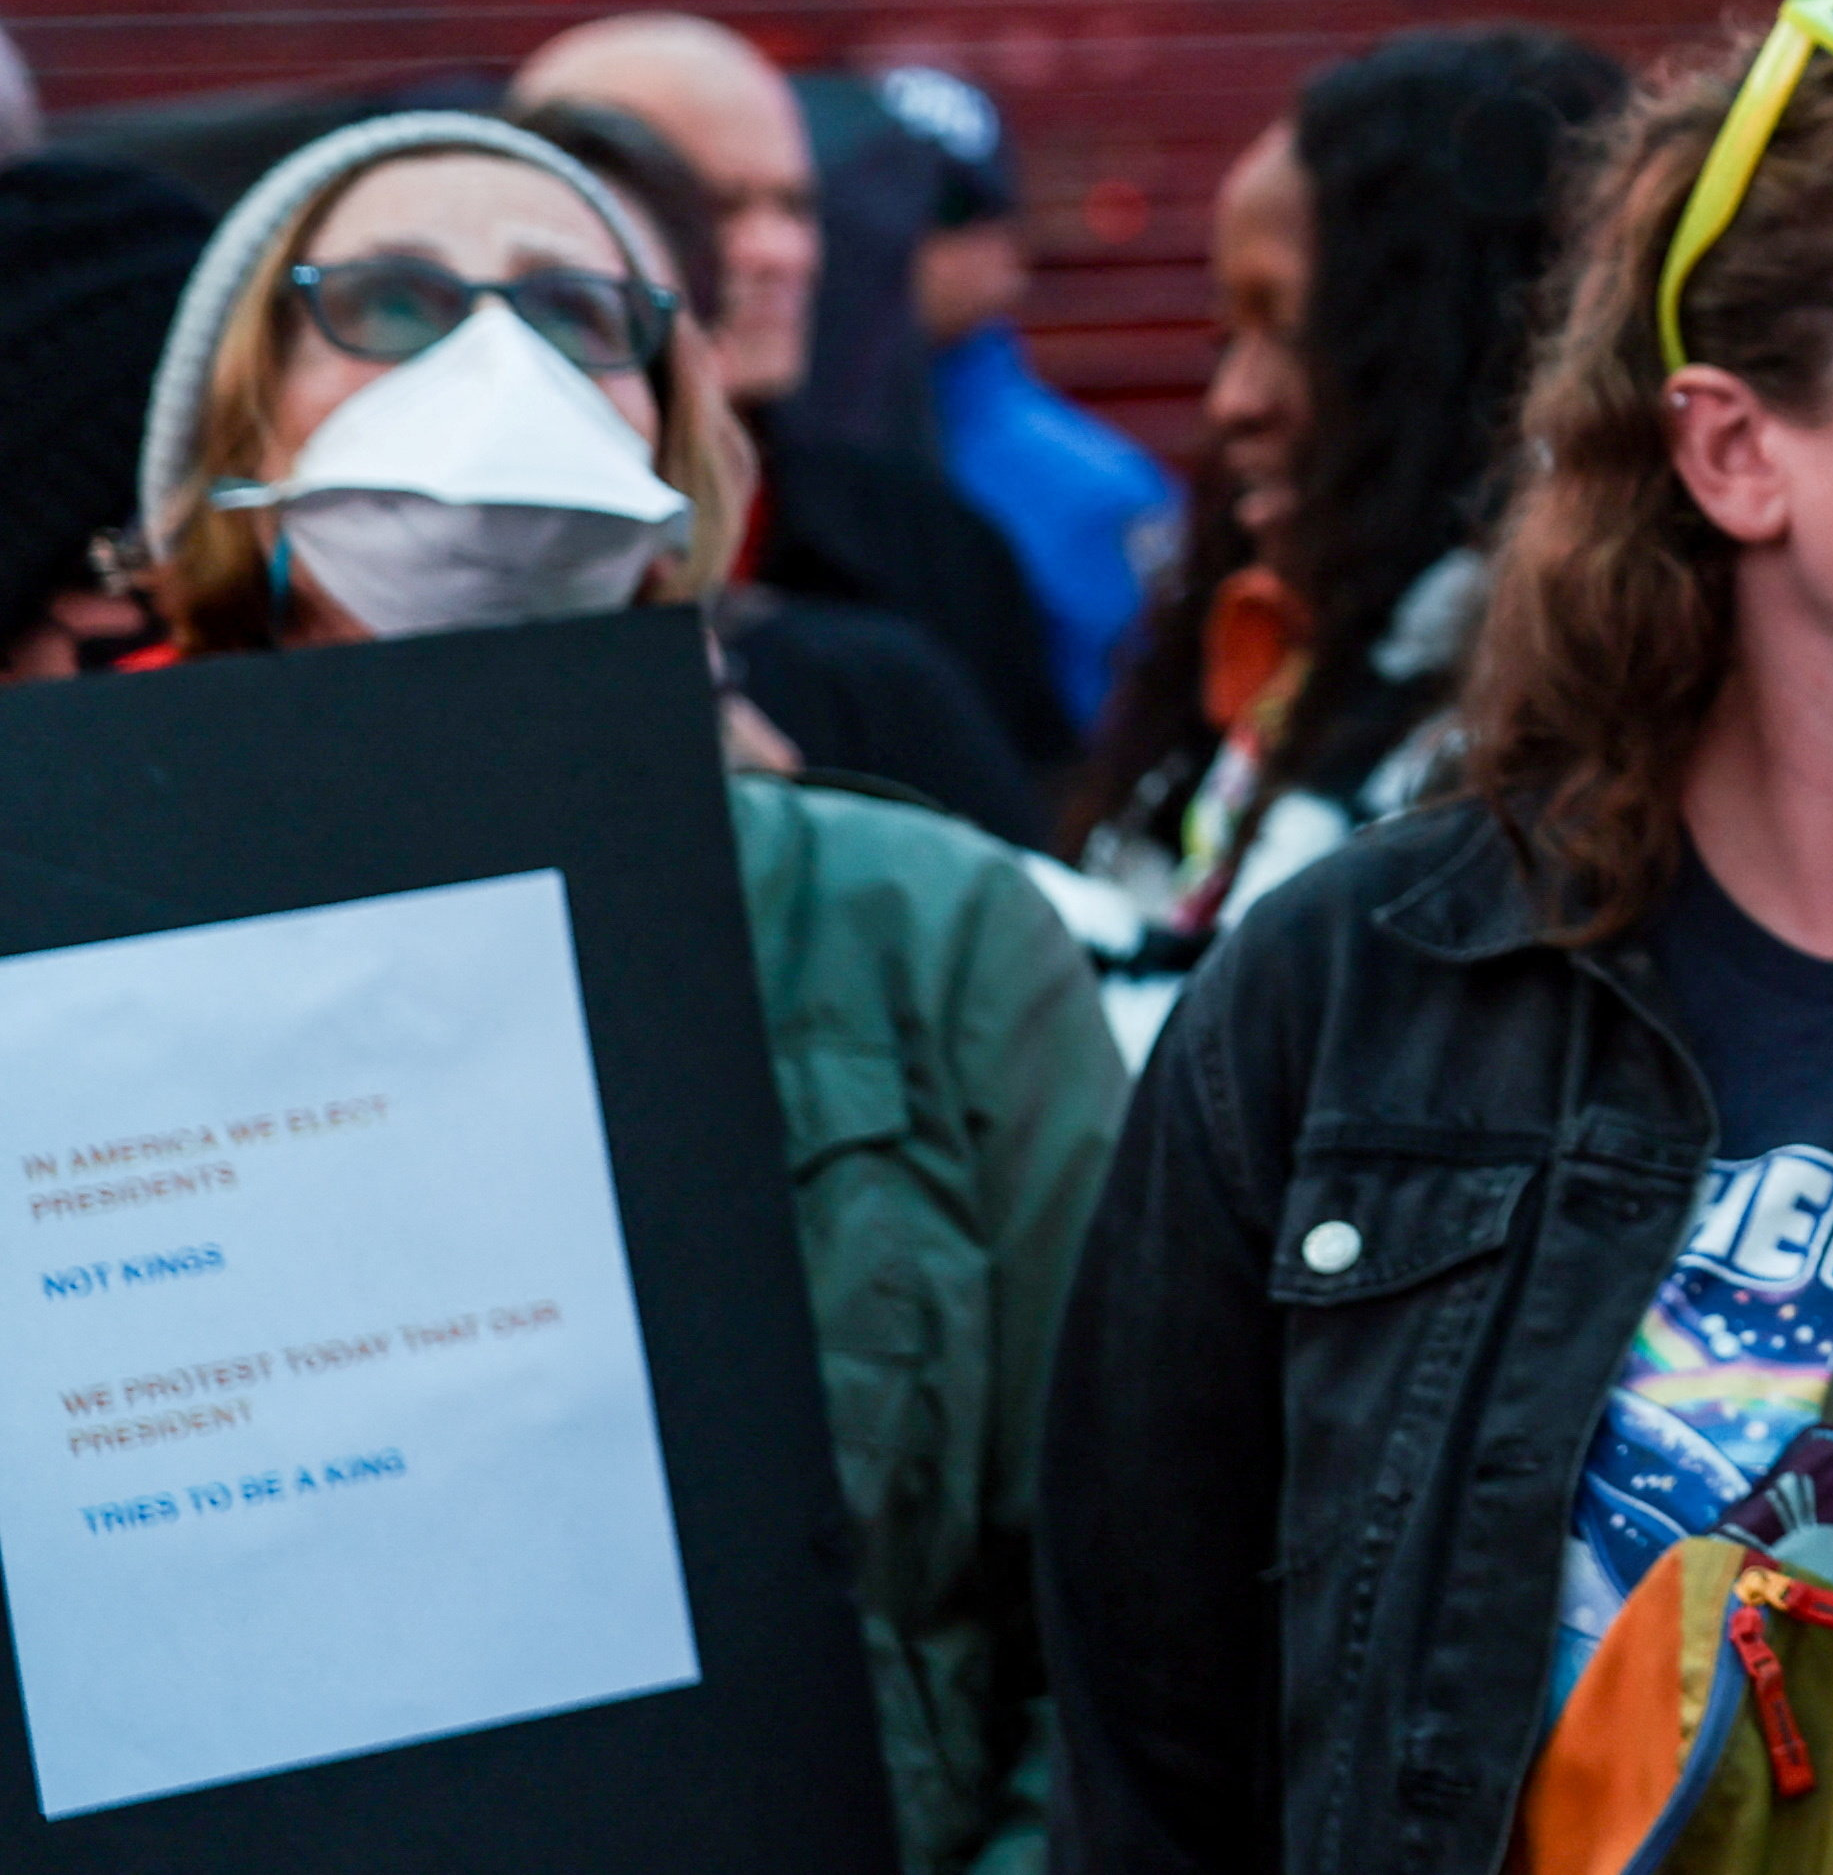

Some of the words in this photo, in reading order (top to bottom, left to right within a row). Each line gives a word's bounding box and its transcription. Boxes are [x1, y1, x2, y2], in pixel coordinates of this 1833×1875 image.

[22, 1152, 58, 1182] IN
[70, 1124, 218, 1175] AMERICA
[225, 1113, 276, 1147] WE
[285, 1093, 389, 1135] ELECT
[30, 1160, 238, 1220] PRESIDENTS
[41, 1259, 110, 1302] NOT
[119, 1241, 227, 1287] KINGS
[60, 1382, 113, 1417] WE
[122, 1351, 274, 1407] PROTEST
[283, 1332, 393, 1376] TODAY
[400, 1312, 480, 1355] THAT
[487, 1298, 562, 1339] OUR
[67, 1397, 254, 1458] PRESIDENT
[79, 1489, 181, 1536] TRIES
[186, 1479, 234, 1516] TO
[240, 1467, 286, 1505] BE
[294, 1463, 319, 1494] A
[323, 1446, 409, 1489] KING
